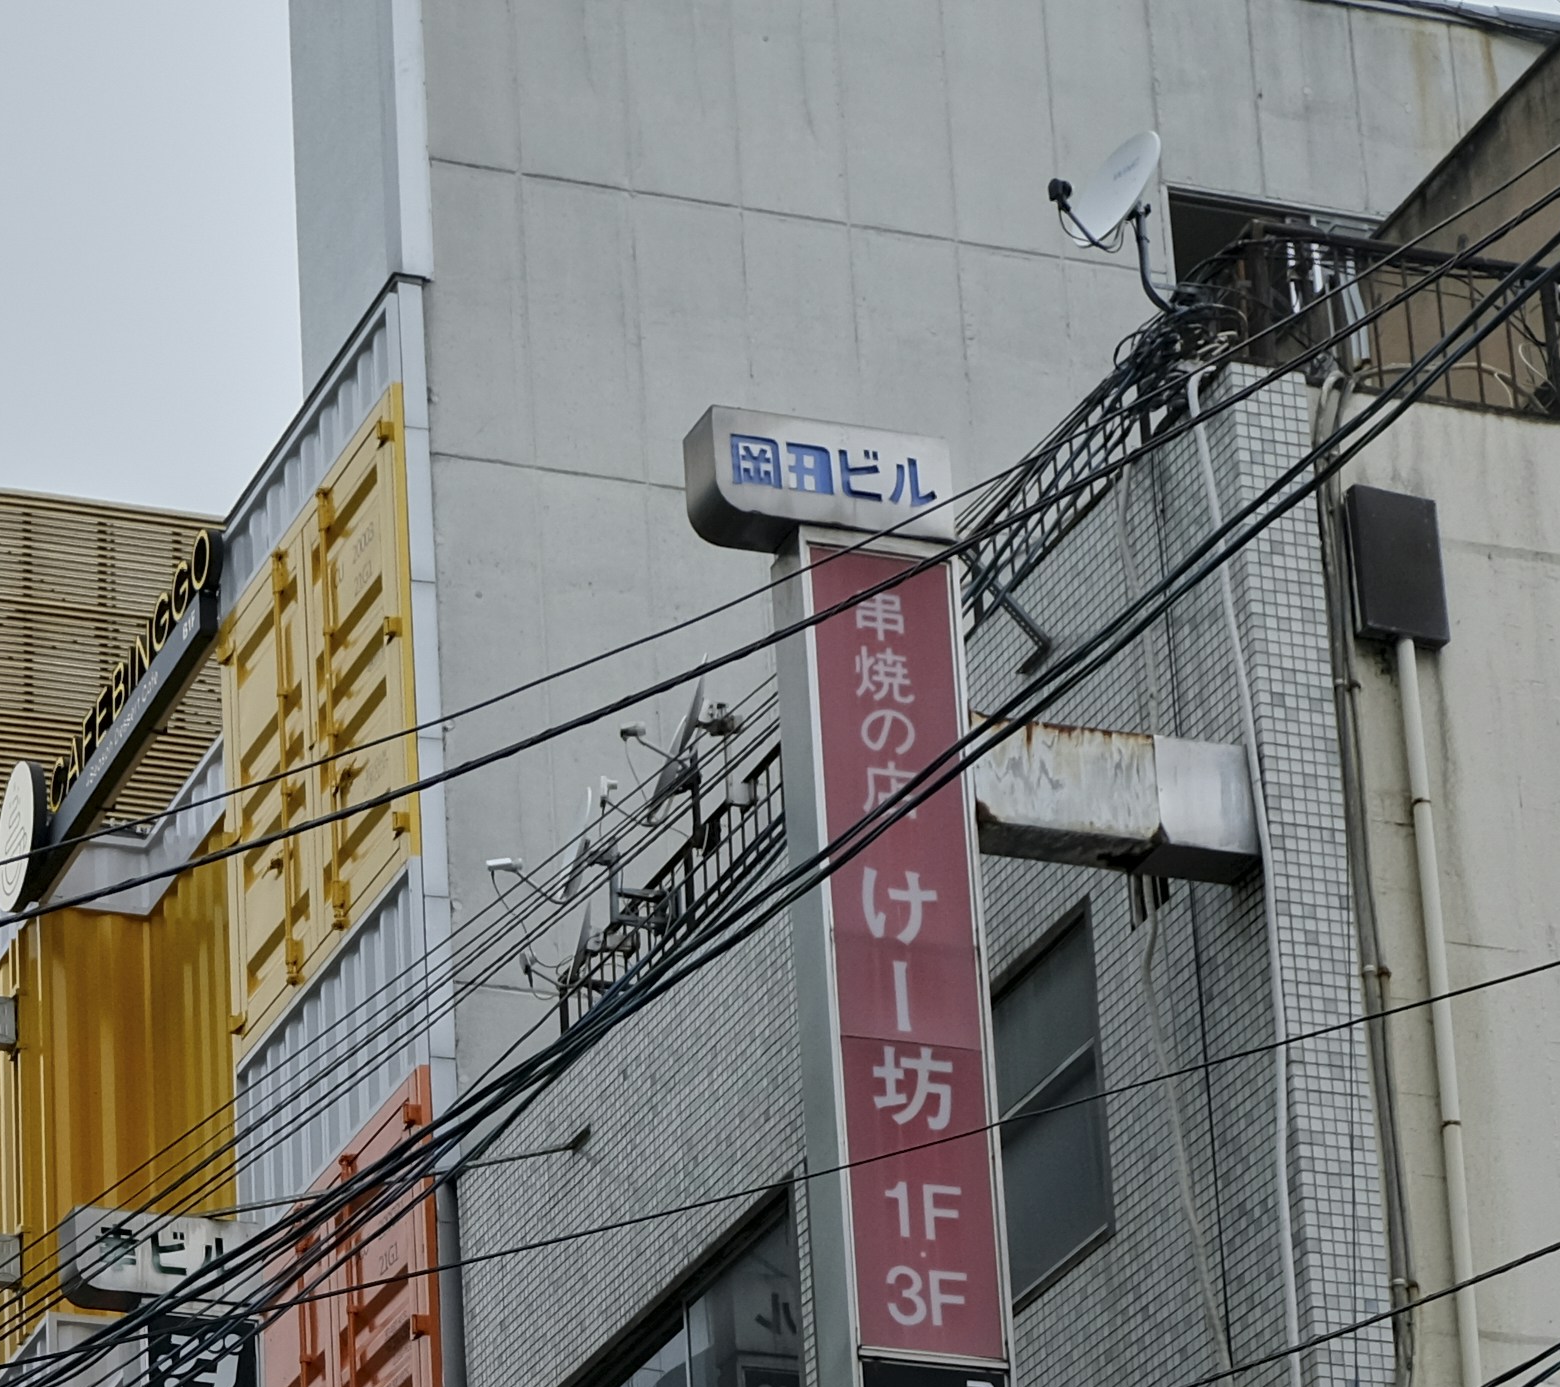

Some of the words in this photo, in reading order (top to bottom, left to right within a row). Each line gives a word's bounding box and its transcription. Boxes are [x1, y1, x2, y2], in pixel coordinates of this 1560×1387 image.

[854, 589, 918, 820] 串焼の店
[861, 867, 954, 1131] けー坊
[885, 1181, 962, 1241] 1F
[886, 1263, 967, 1327] 3F
